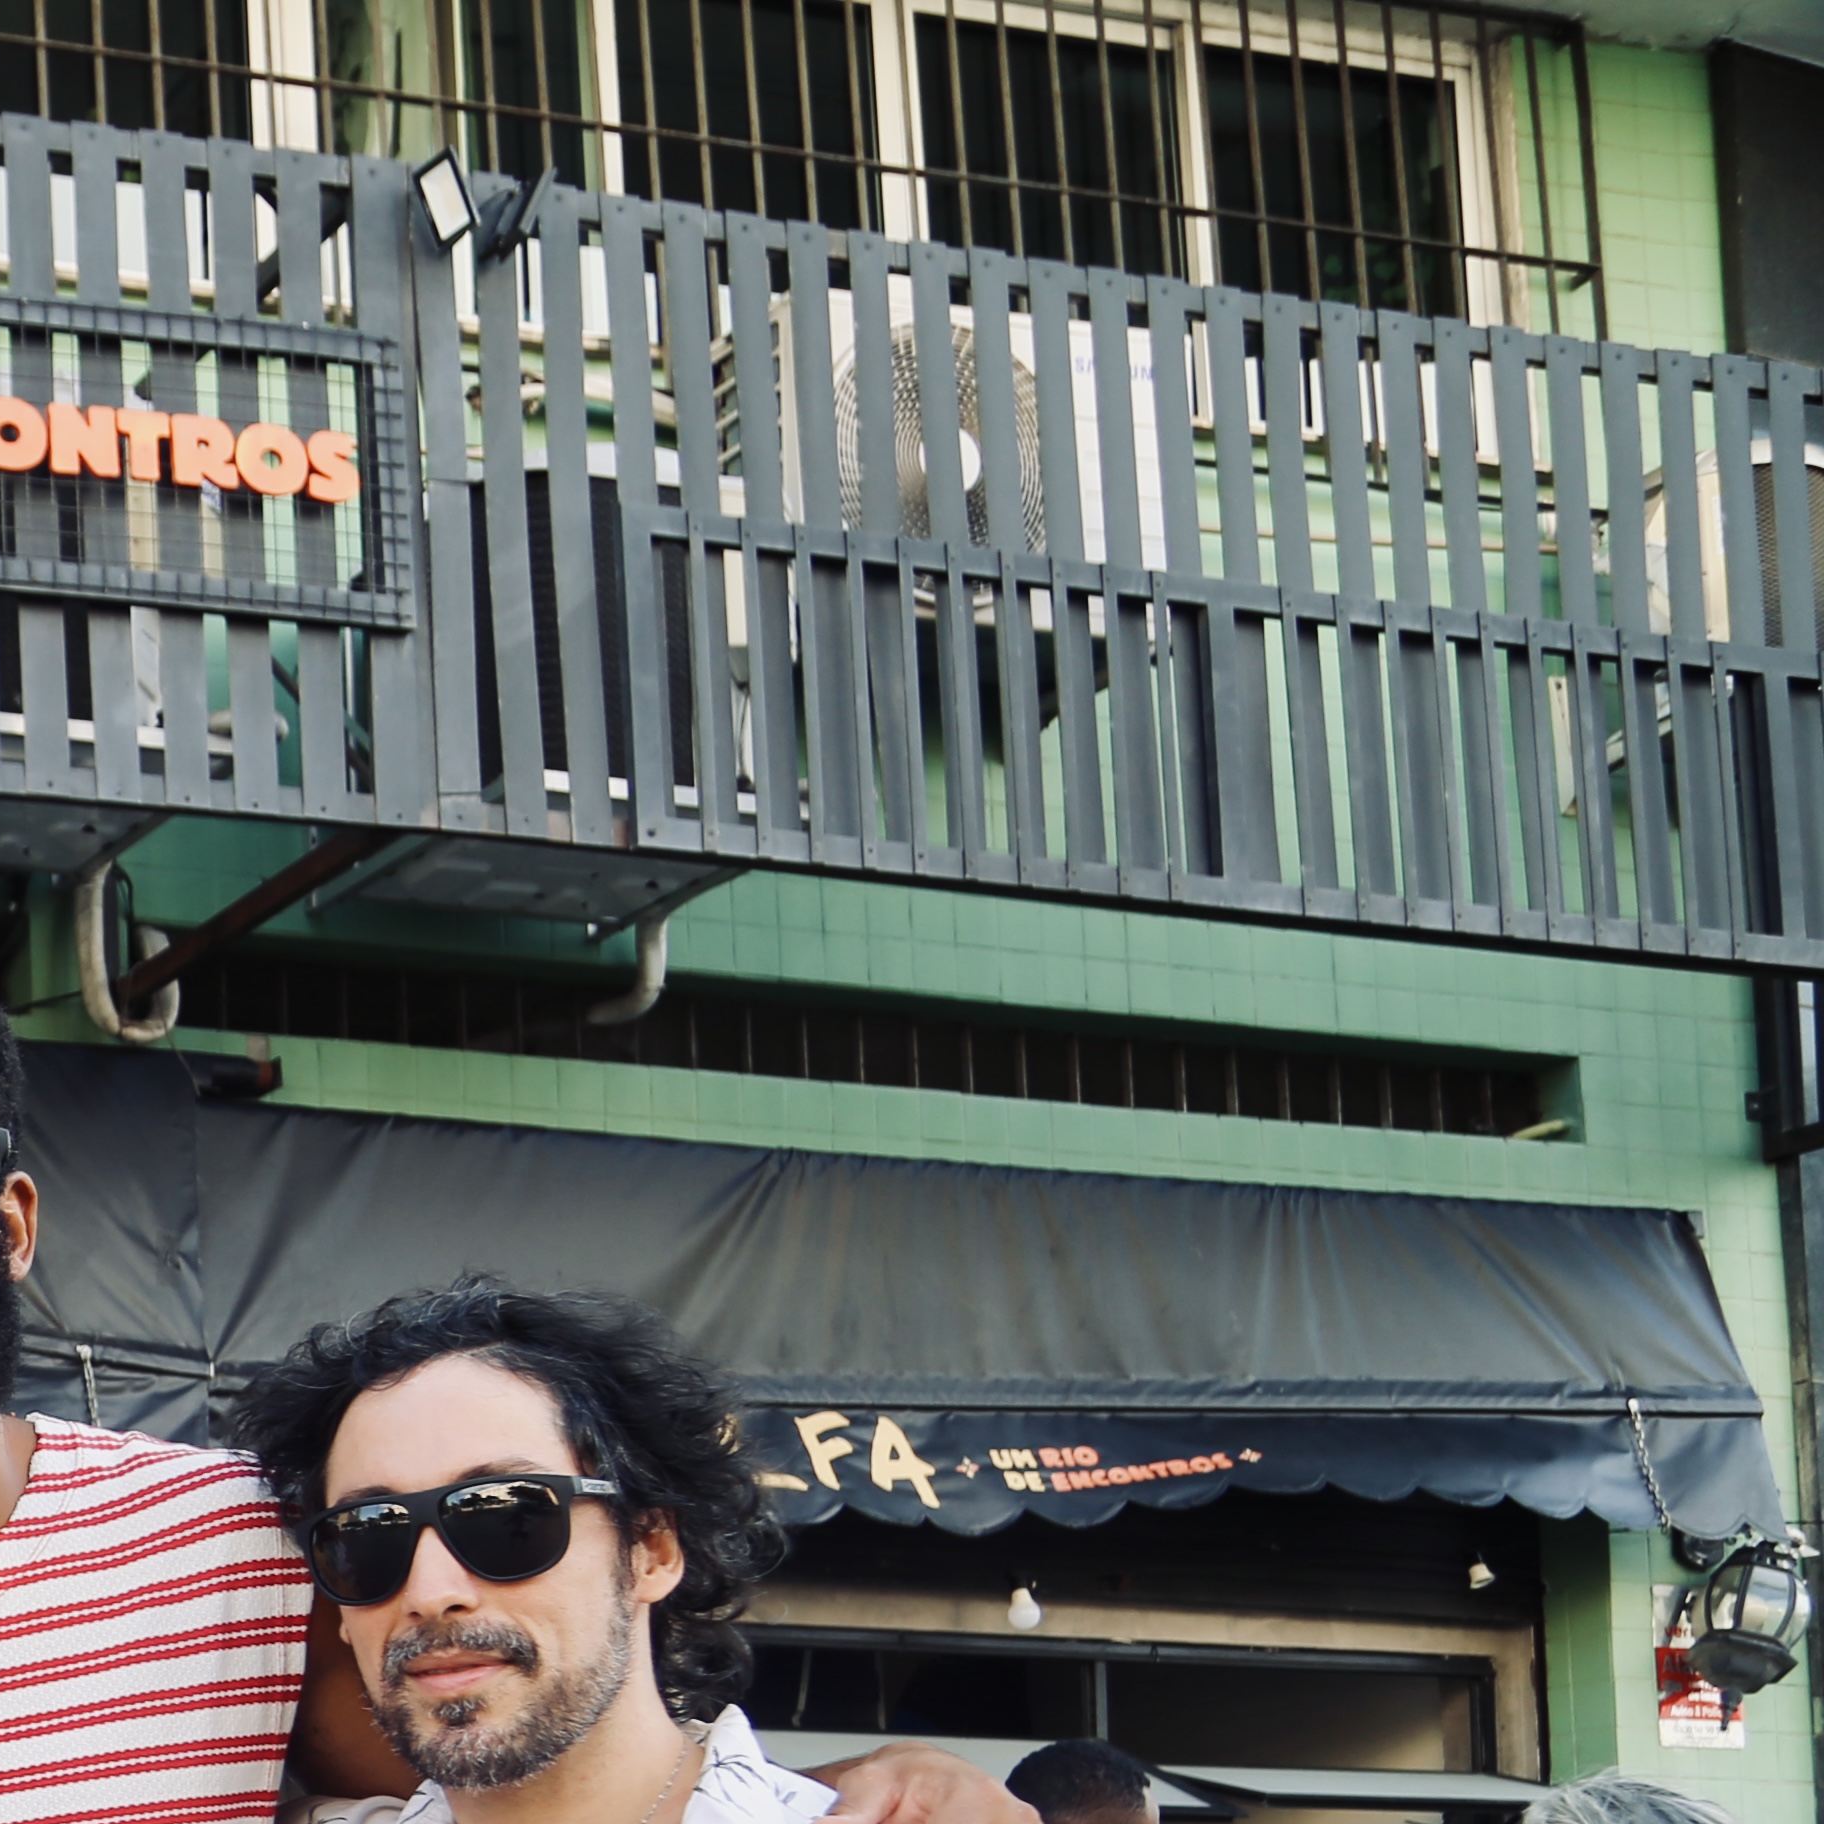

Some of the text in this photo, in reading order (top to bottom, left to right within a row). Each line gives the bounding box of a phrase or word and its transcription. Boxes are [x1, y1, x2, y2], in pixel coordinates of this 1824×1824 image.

[712, 1410, 941, 1510] FA
[989, 1445, 1100, 1469] UM RIO
[1003, 1452, 1234, 1493] DE ENCONTROS
